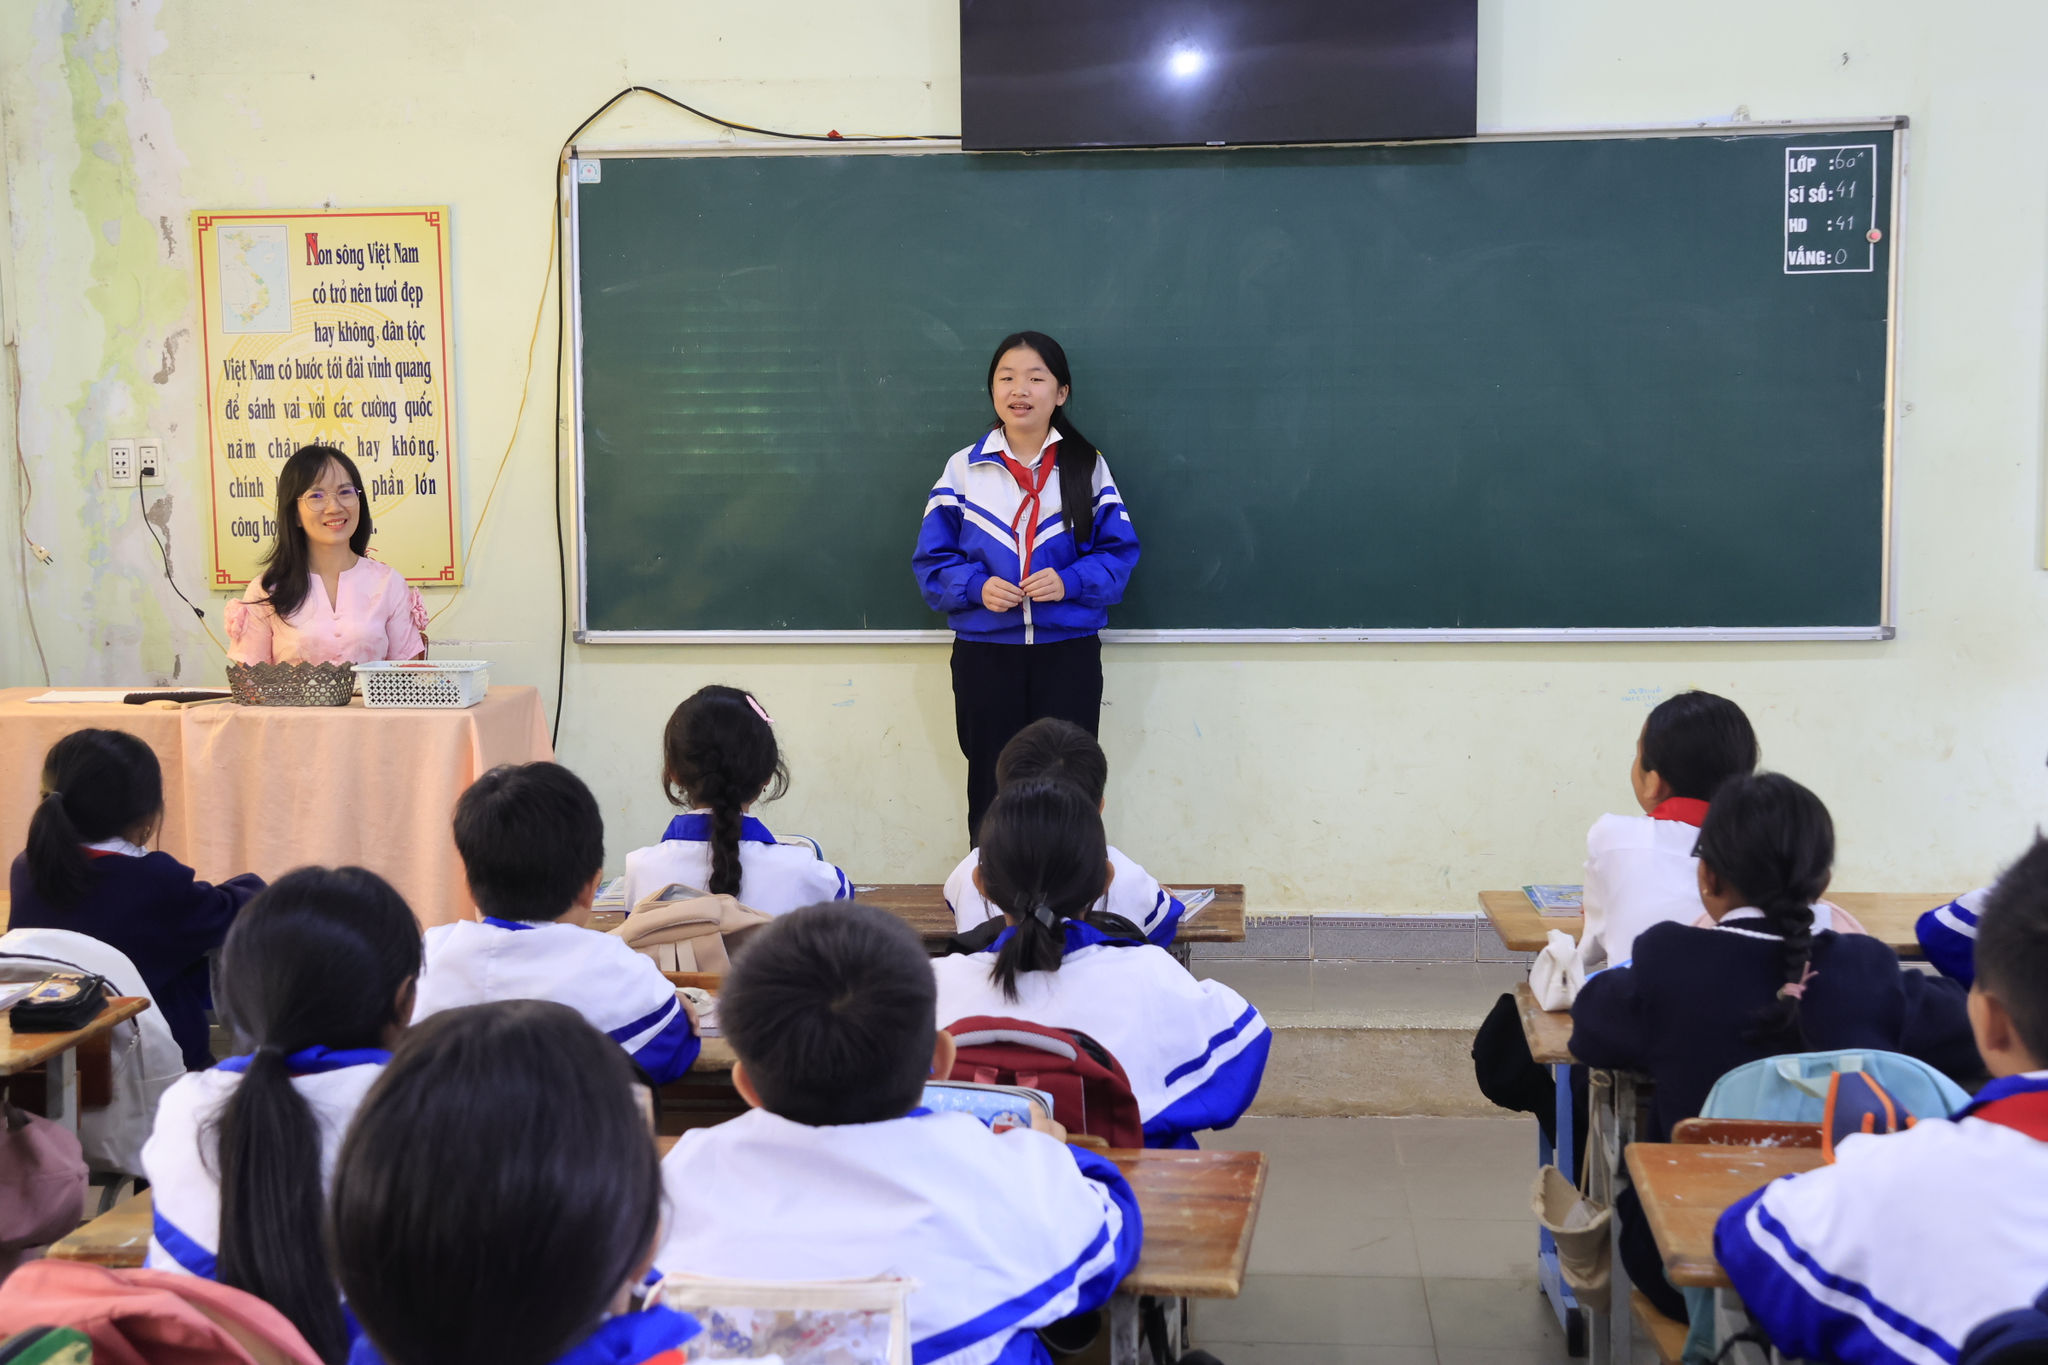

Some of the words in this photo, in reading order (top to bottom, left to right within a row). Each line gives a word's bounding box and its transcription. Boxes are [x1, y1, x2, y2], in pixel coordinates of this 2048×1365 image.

[1789, 155, 1817, 173] LỚP
[1788, 218, 1808, 232] HD
[305, 233, 332, 265] Non
[336, 244, 365, 271] sông
[367, 241, 391, 270] Việt
[394, 243, 419, 263] Nam
[313, 281, 326, 304] có
[330, 279, 347, 303] trở
[351, 282, 372, 303] nên
[375, 280, 398, 302] tươi
[401, 281, 423, 308] đẹp
[314, 322, 335, 347] hay
[382, 321, 404, 341] dân
[407, 323, 426, 346] tộc
[223, 359, 247, 387] Việt
[250, 360, 275, 380] Nam
[278, 358, 292, 379] có
[296, 358, 324, 379] bước
[327, 357, 343, 379] tới
[346, 356, 364, 378] đài
[367, 357, 392, 378] vinh
[395, 360, 432, 384] quang
[225, 394, 240, 420] để
[248, 398, 276, 419] sánh
[284, 399, 300, 419] vai
[309, 398, 325, 419] với
[334, 399, 353, 418] các
[362, 398, 397, 424] cường
[405, 391, 433, 423] quốc
[227, 439, 256, 458] năm
[357, 436, 381, 462] hay
[392, 435, 439, 462] không,
[229, 476, 264, 498] chính
[372, 469, 404, 501] phần
[416, 472, 437, 494] lớn
[231, 517, 260, 543] công
